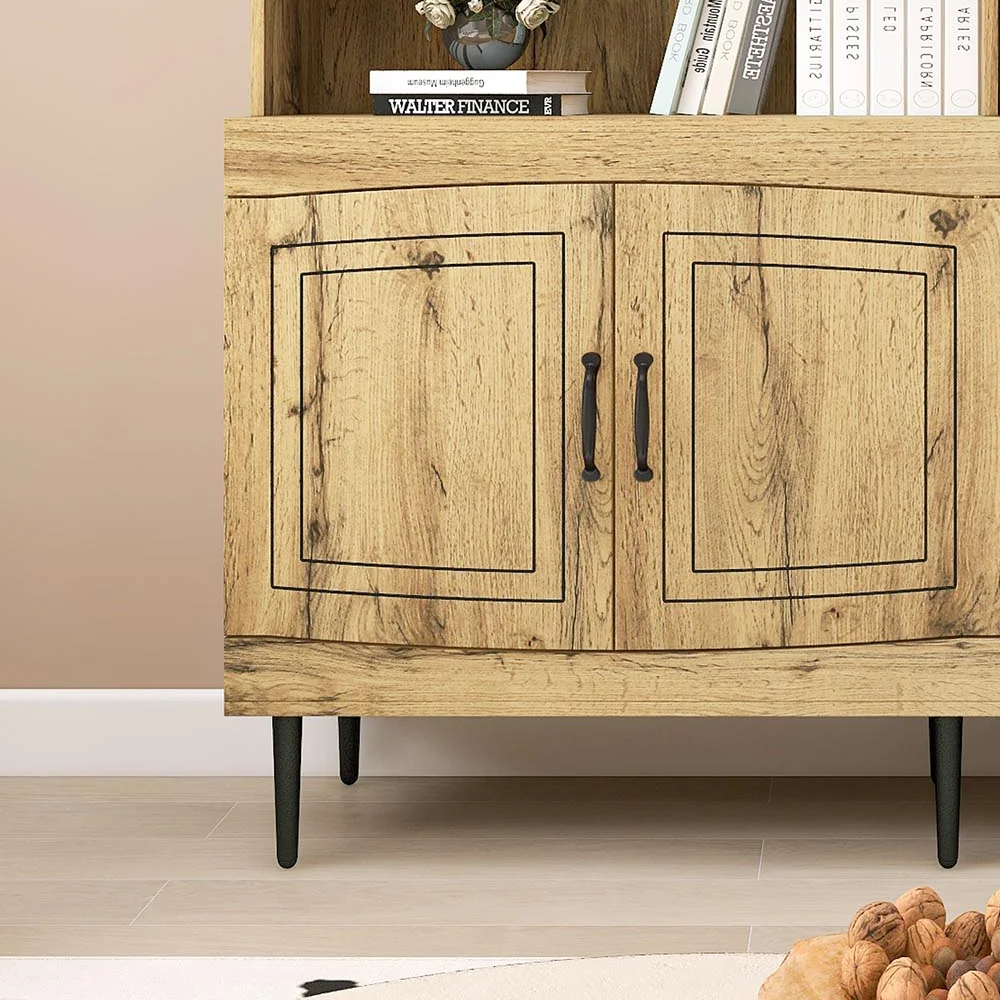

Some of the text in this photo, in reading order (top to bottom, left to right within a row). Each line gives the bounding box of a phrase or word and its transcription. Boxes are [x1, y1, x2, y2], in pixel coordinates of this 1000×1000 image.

[407, 77, 485, 88] Guggenheim Museum
[388, 98, 530, 114] WALTER FINANCE
